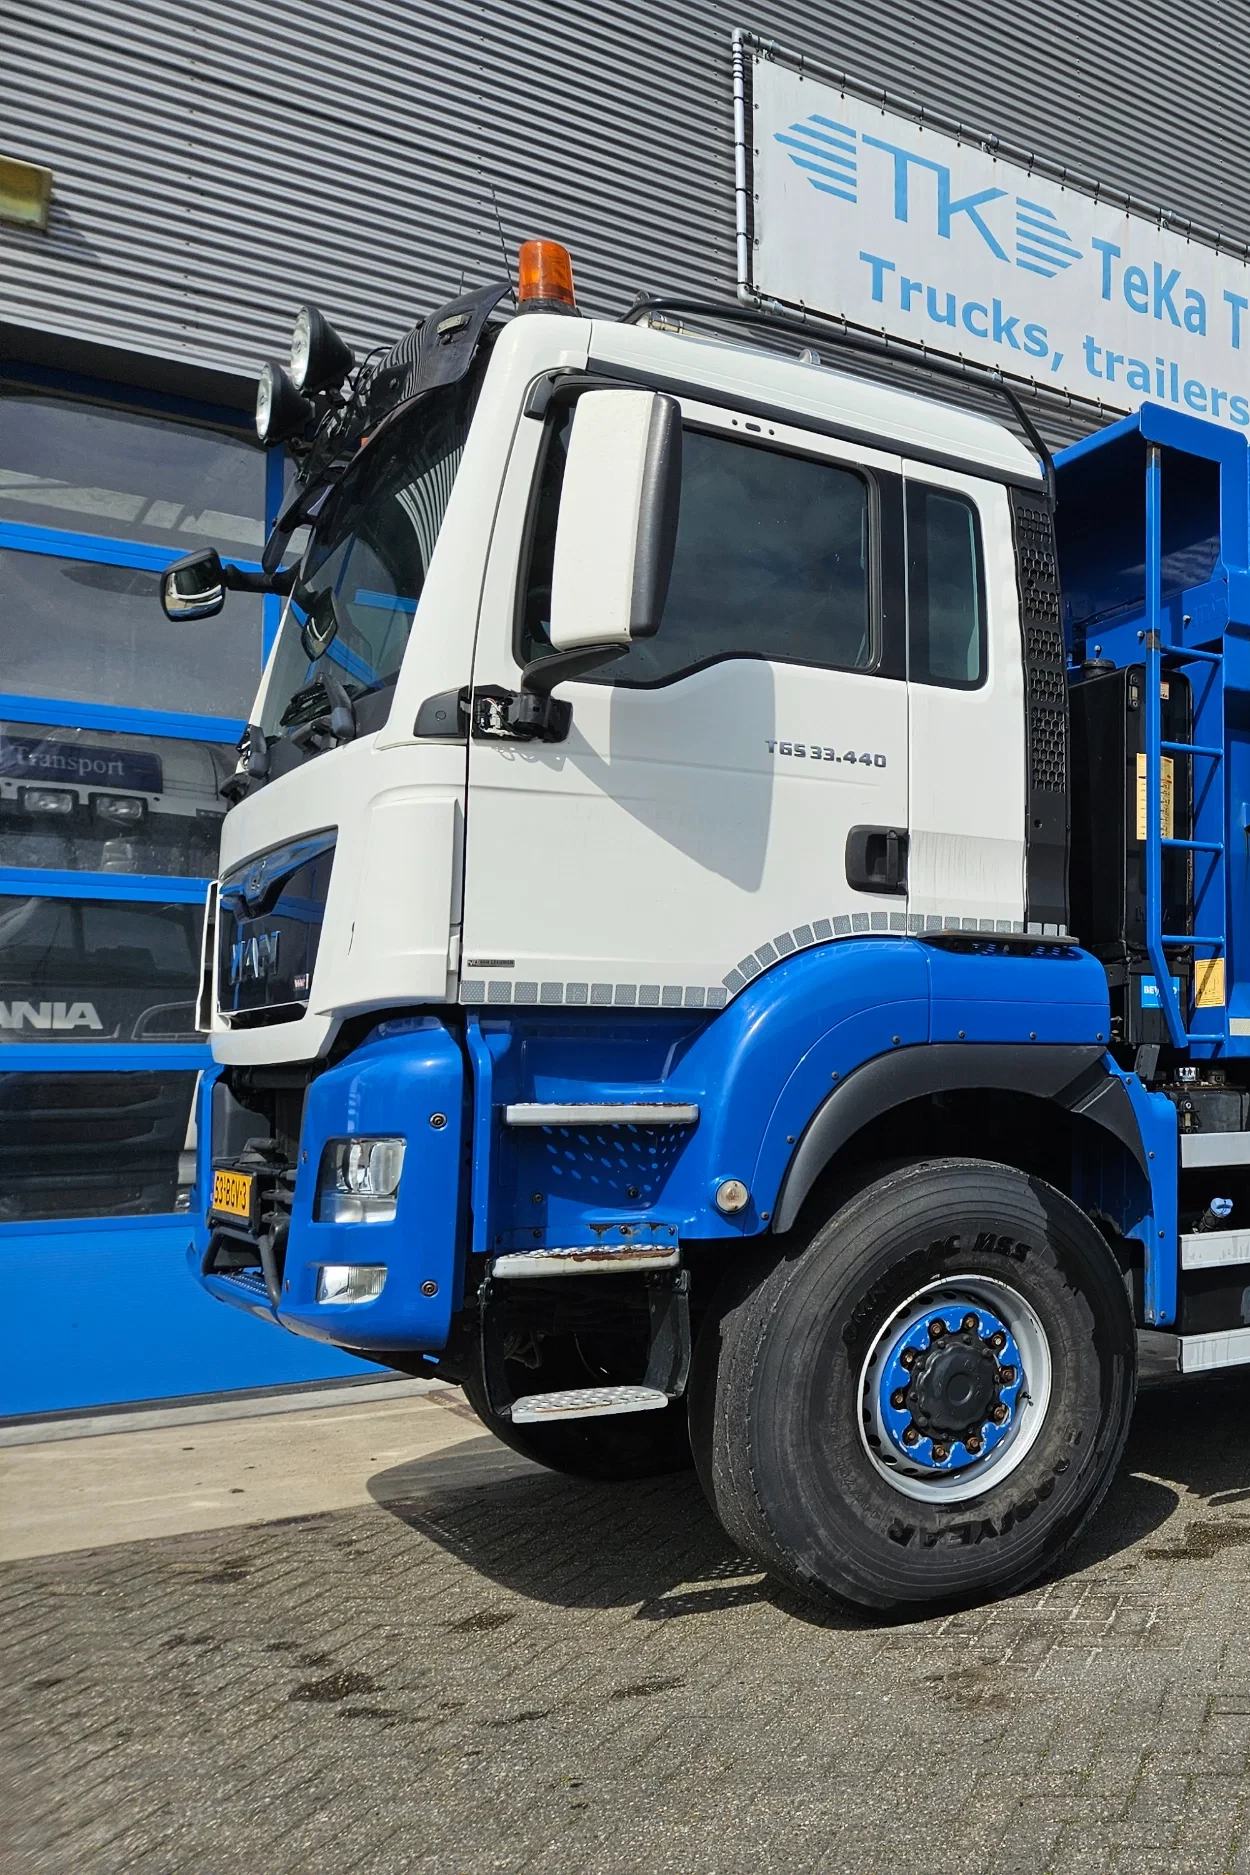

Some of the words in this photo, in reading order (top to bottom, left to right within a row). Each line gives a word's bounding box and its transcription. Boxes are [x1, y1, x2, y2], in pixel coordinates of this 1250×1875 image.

[859, 252, 1063, 372] Trucks,
[1092, 238, 1207, 336] TeKa
[12, 745, 125, 776] Transport
[765, 740, 806, 757] TGS
[810, 745, 886, 768] 33.440
